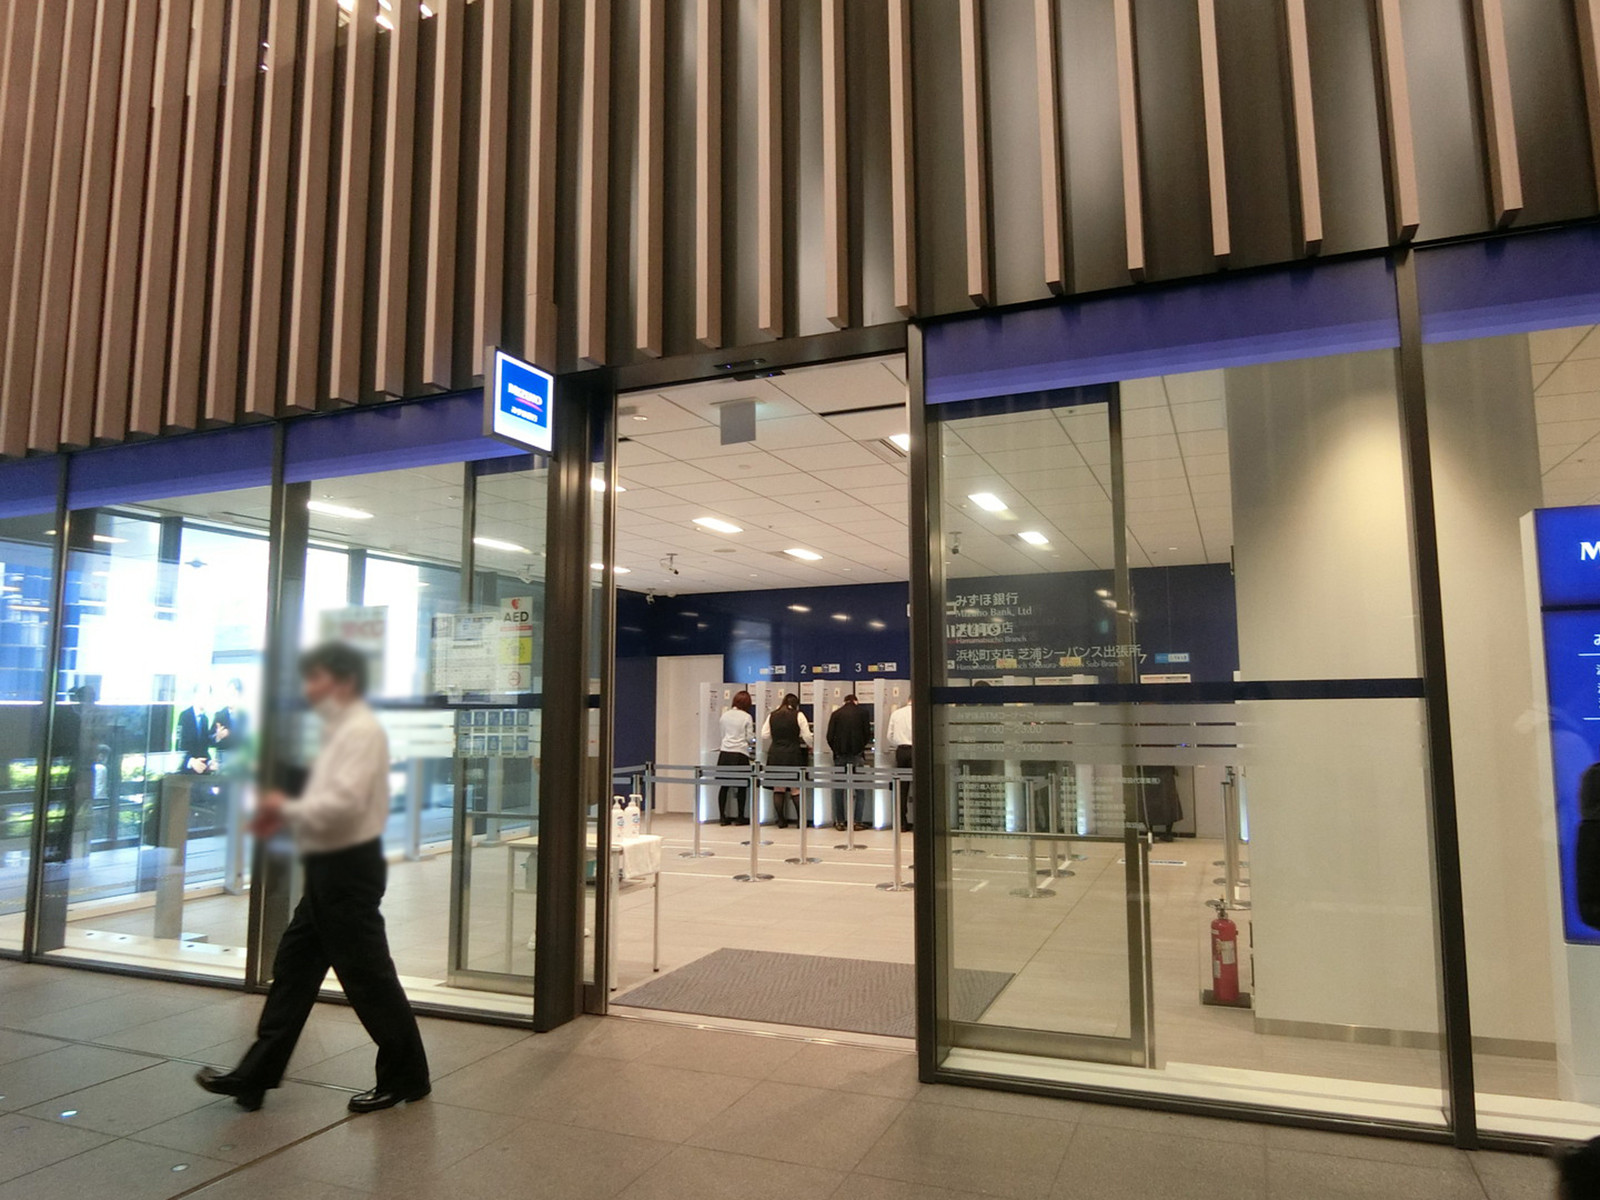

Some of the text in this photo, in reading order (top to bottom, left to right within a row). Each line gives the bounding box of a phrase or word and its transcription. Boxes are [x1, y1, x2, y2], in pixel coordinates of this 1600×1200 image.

[955, 591, 1019, 607] みずほ銀行
[503, 611, 529, 623] AED
[955, 649, 1014, 662] 浜松町支店
[1138, 653, 1147, 664] 7
[800, 664, 807, 674] 2
[855, 663, 862, 672] 3
